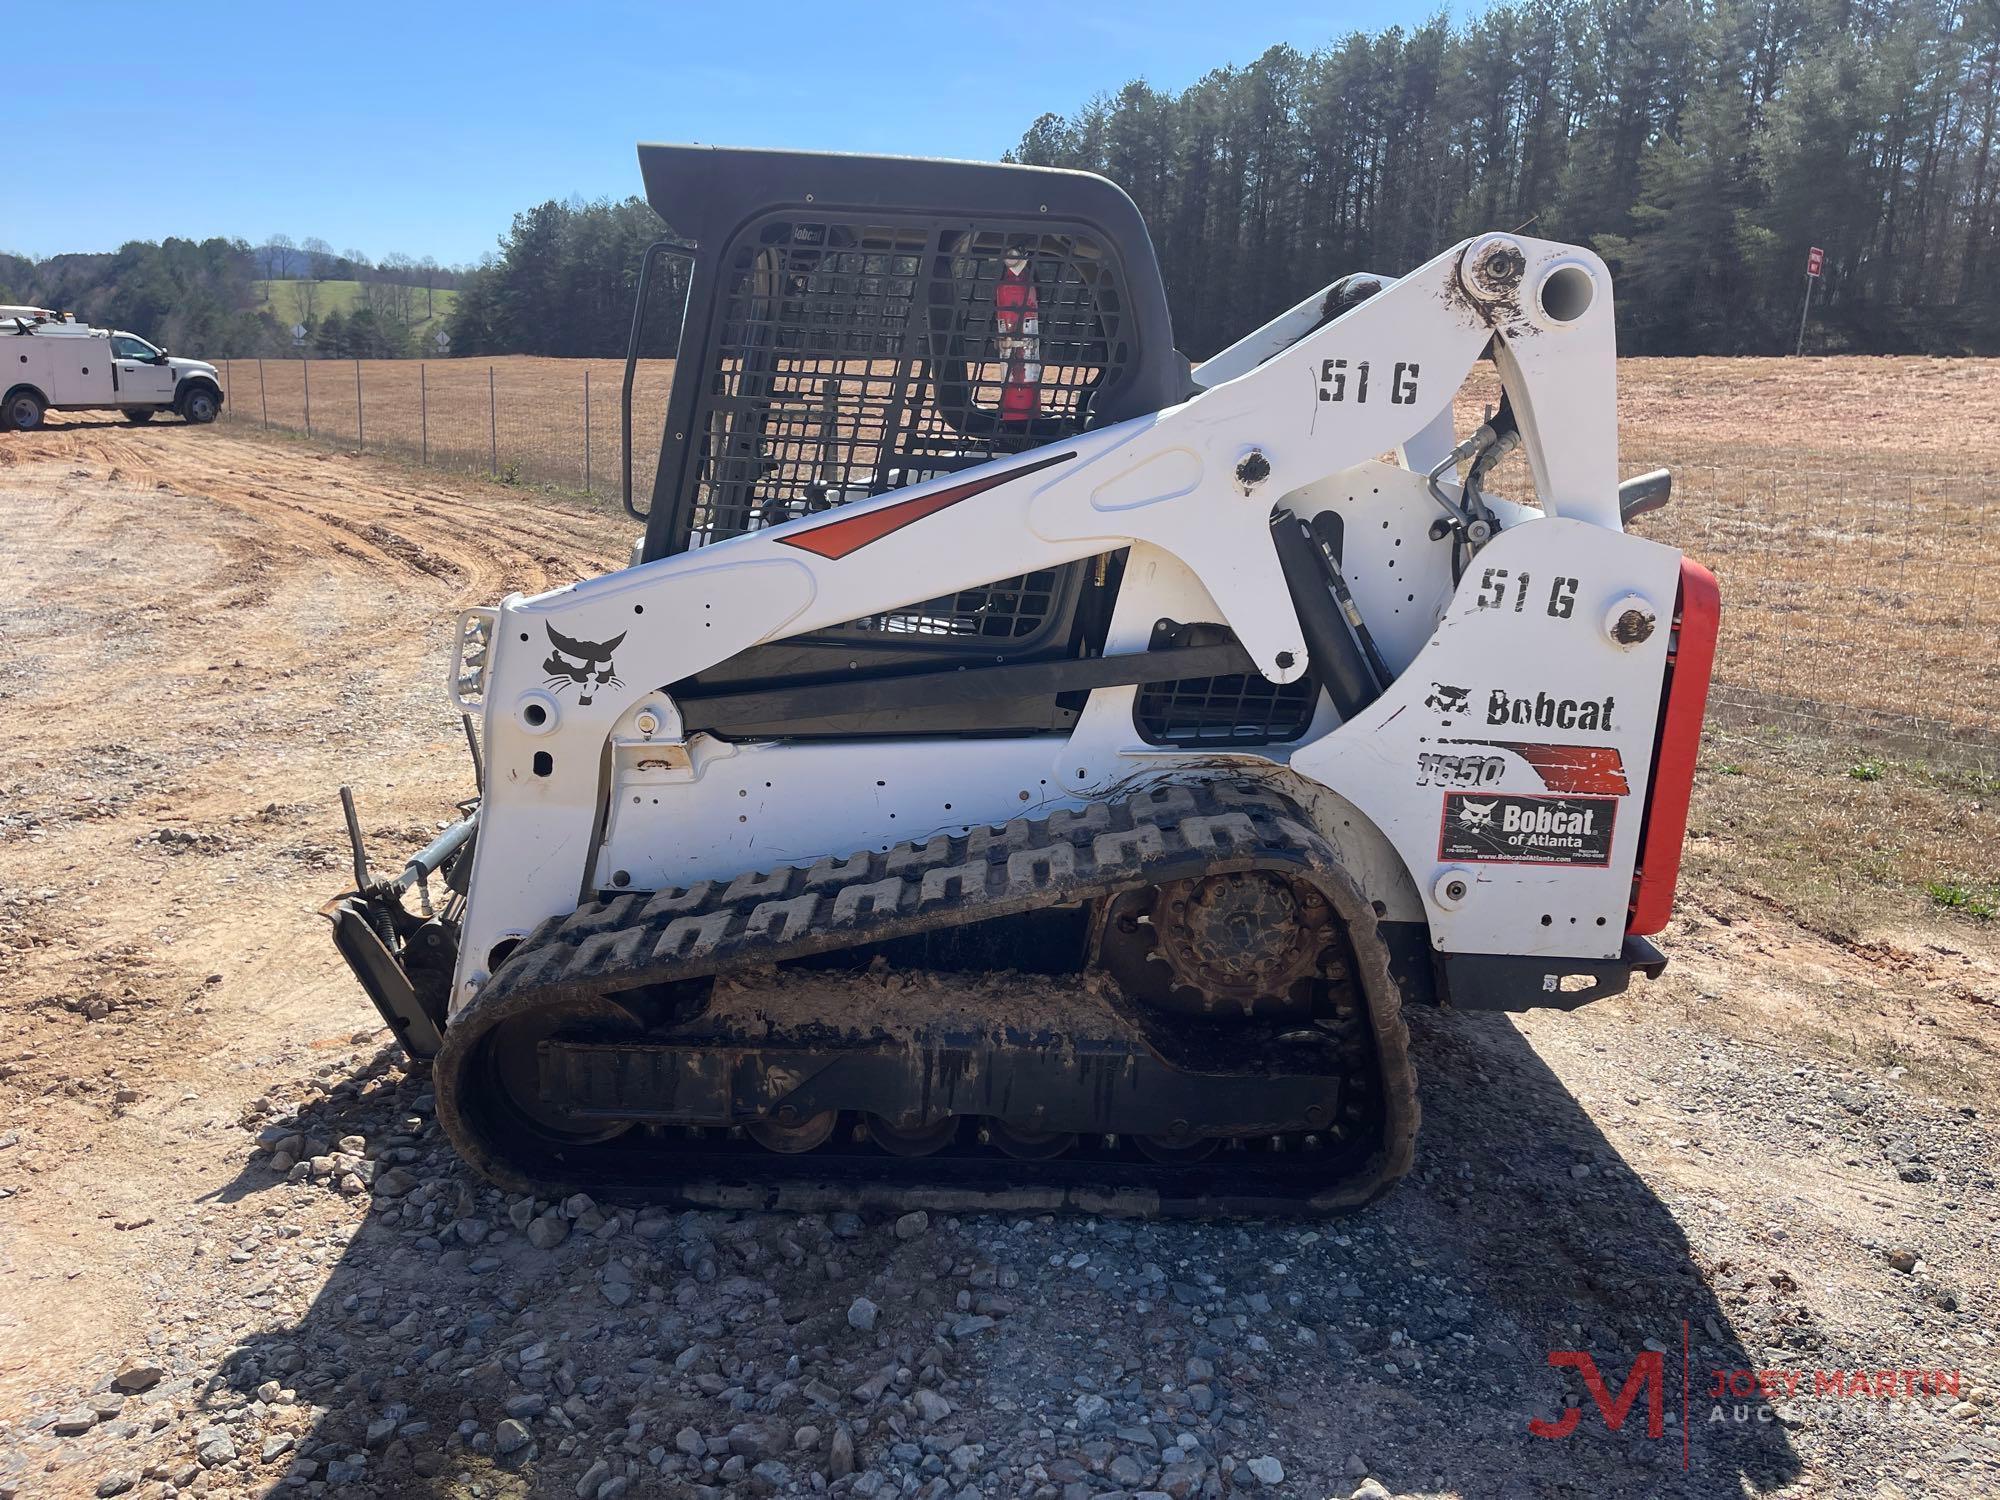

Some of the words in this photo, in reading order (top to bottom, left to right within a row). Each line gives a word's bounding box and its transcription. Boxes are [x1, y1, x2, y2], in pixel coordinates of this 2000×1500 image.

[1319, 359, 1370, 403] 51
[1391, 362, 1420, 404] G
[1477, 568, 1530, 612] 51
[1547, 576, 1579, 619] G
[1487, 690, 1615, 731] Bobcat
[1416, 752, 1506, 788] T650
[1503, 805, 1594, 836] Bobcat
[1508, 835, 1524, 846] of
[1528, 834, 1583, 848] Atlanta
